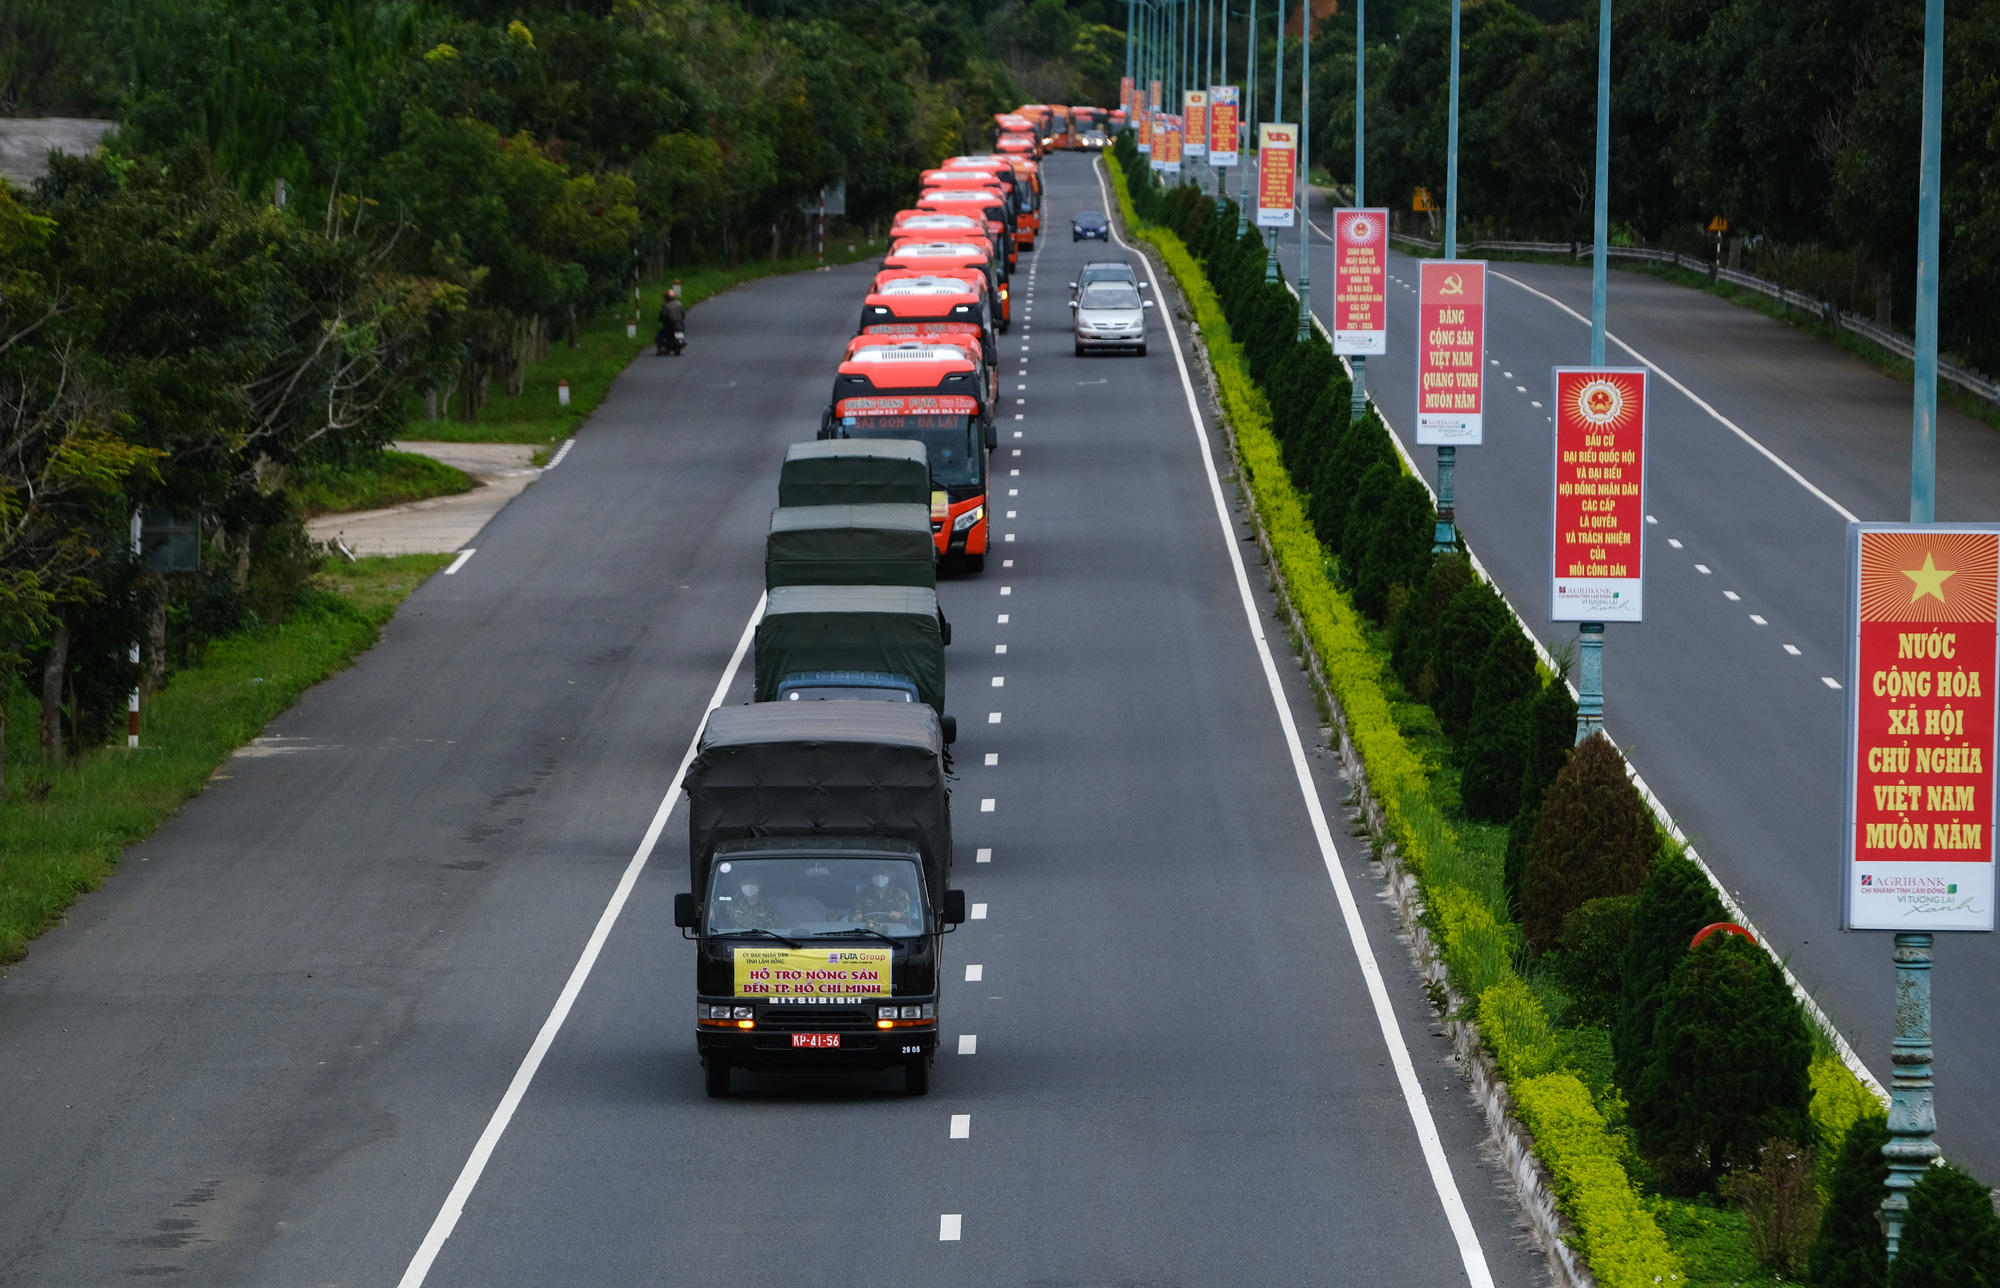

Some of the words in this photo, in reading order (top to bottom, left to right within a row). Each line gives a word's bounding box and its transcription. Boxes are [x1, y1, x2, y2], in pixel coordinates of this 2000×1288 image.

[1439, 306, 1464, 324] ĐẢNG
[1430, 327, 1454, 349] CỘNG
[1457, 327, 1474, 346] SẢN
[1430, 348, 1450, 370] VIỆT
[1452, 352, 1472, 366] NAM
[1424, 372, 1454, 390] QUANG
[1456, 373, 1478, 388] VINH
[878, 398, 904, 408] TRANG
[909, 398, 936, 408] FUTA
[939, 398, 954, 407] Bus
[1426, 390, 1453, 408] MUÔN
[1455, 391, 1475, 408] NĂM
[1585, 432, 1601, 447] BẦU
[1603, 431, 1615, 447] CỬ
[1563, 451, 1578, 465] ĐẠI
[1579, 447, 1597, 463] BIỂU
[1599, 448, 1620, 464] QUỐC
[1622, 449, 1635, 465] HỘI
[1577, 465, 1587, 479] VÀ
[1589, 468, 1602, 481] ĐẠI
[1604, 464, 1622, 479] BIỂU
[1560, 481, 1573, 498] HỘI
[1574, 481, 1596, 496] ĐỒNG
[1598, 482, 1620, 495] NHÂN
[1623, 481, 1638, 496] DÂN
[1582, 497, 1598, 512] CÁC
[1600, 496, 1615, 512] CẤP
[1580, 514, 1590, 528] LÀ
[1592, 513, 1617, 528] QUYỀN
[1566, 530, 1576, 543] VÀ
[1578, 529, 1603, 545] TRÁCH
[1605, 530, 1631, 547] NHIỆM
[1590, 545, 1606, 560] CỦA
[1569, 561, 1585, 576] MỖI
[1587, 562, 1608, 576] CÔNG
[1610, 562, 1627, 576] DÂN
[1898, 627, 1956, 659] NƯỚC
[1873, 666, 1931, 703] CỘNG
[1937, 668, 1981, 698] HÒA
[1888, 703, 1920, 735] XÃ
[1925, 704, 1964, 741] HỘI
[1868, 740, 1910, 773] CHỦ
[1916, 742, 1982, 773] NGHĨA
[1874, 781, 1921, 817] VIỆT
[1927, 786, 1975, 811] NAM
[1866, 817, 1929, 850] MUÔN
[1933, 818, 1981, 850] NĂM
[1875, 877, 1945, 886] AGRIBANK
[860, 953, 885, 962] Group
[750, 968, 770, 980] HỖ
[774, 969, 802, 981] TRỢ
[806, 969, 847, 980] NÔNG
[851, 968, 878, 980] SẢN
[743, 982, 769, 993] ĐẾN
[774, 984, 789, 993] TP.
[795, 981, 814, 993] HỒ
[819, 983, 841, 993] CHÍ
[845, 984, 881, 993] MINH
[793, 1035, 839, 1047] KP-41-56
